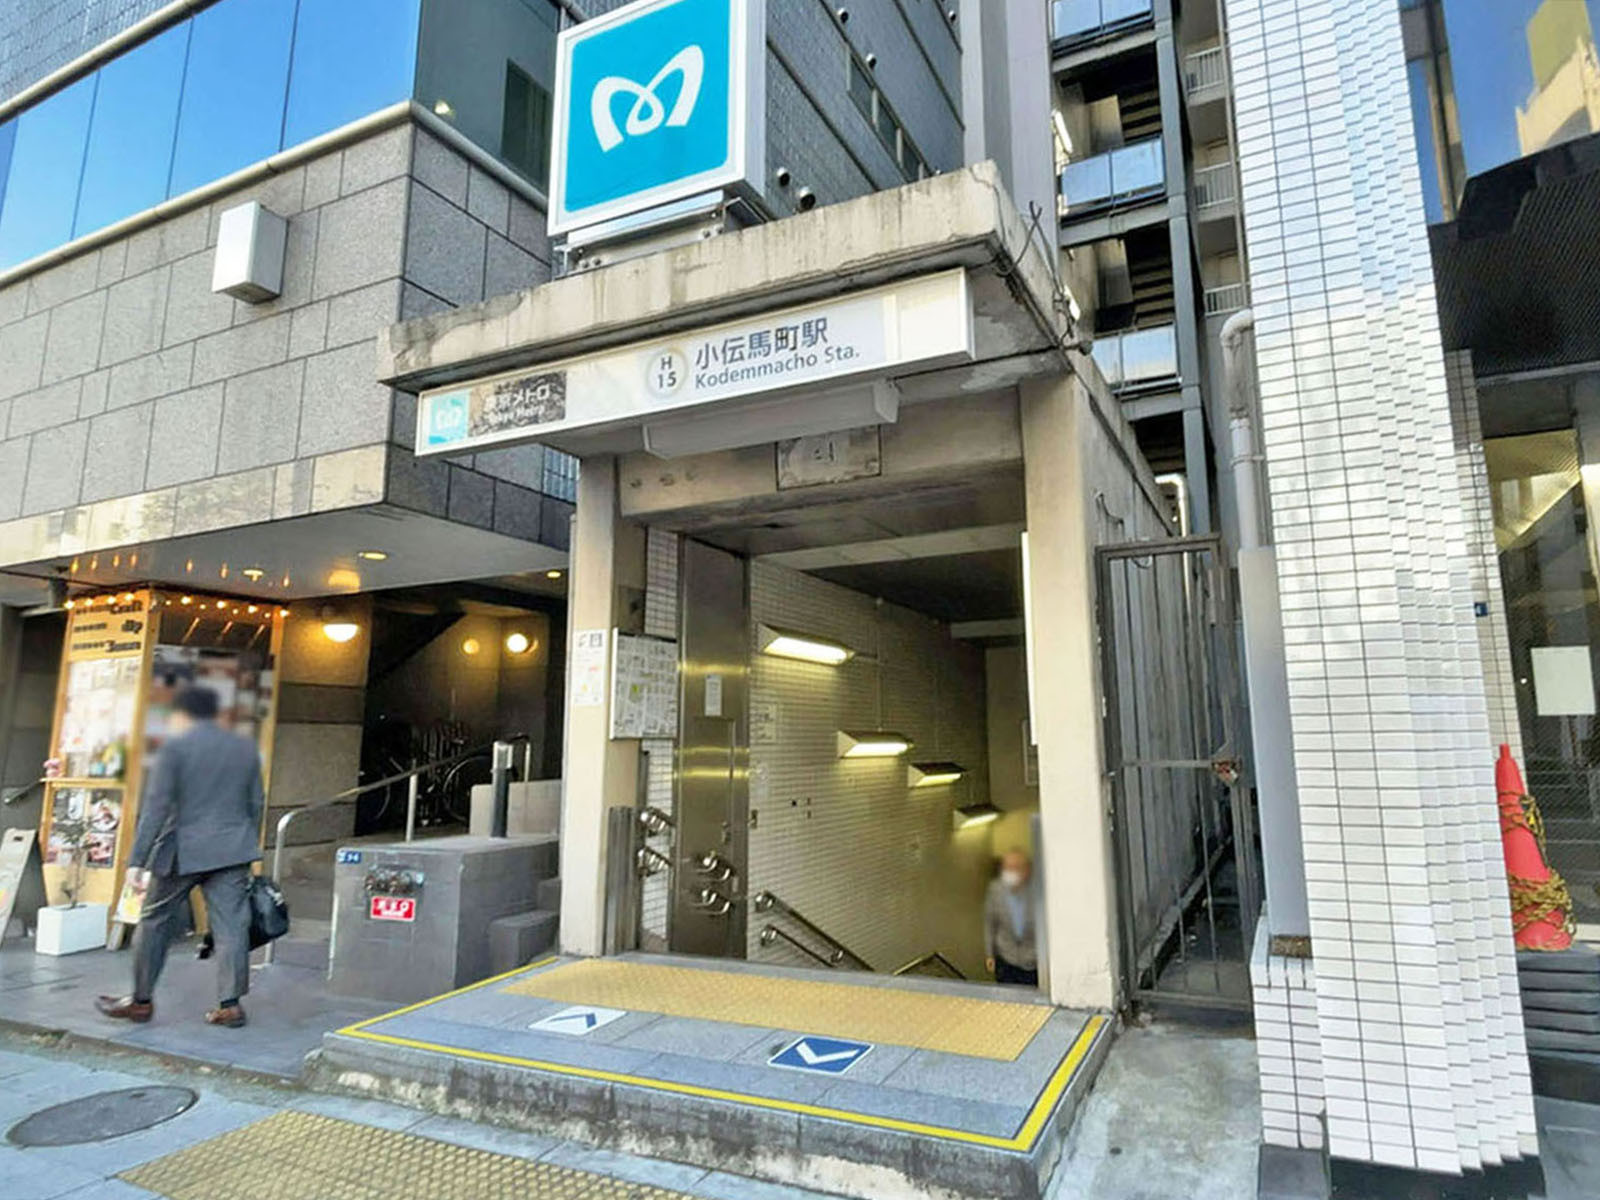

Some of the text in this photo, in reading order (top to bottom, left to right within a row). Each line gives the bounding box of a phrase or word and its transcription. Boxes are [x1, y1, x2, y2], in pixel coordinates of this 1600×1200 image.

[695, 317, 829, 370] 小伝馬町駅
[660, 355, 673, 371] H
[695, 345, 861, 389] Kodemmacho Sta.
[658, 370, 677, 389] 15
[483, 382, 550, 413] 京メトロ
